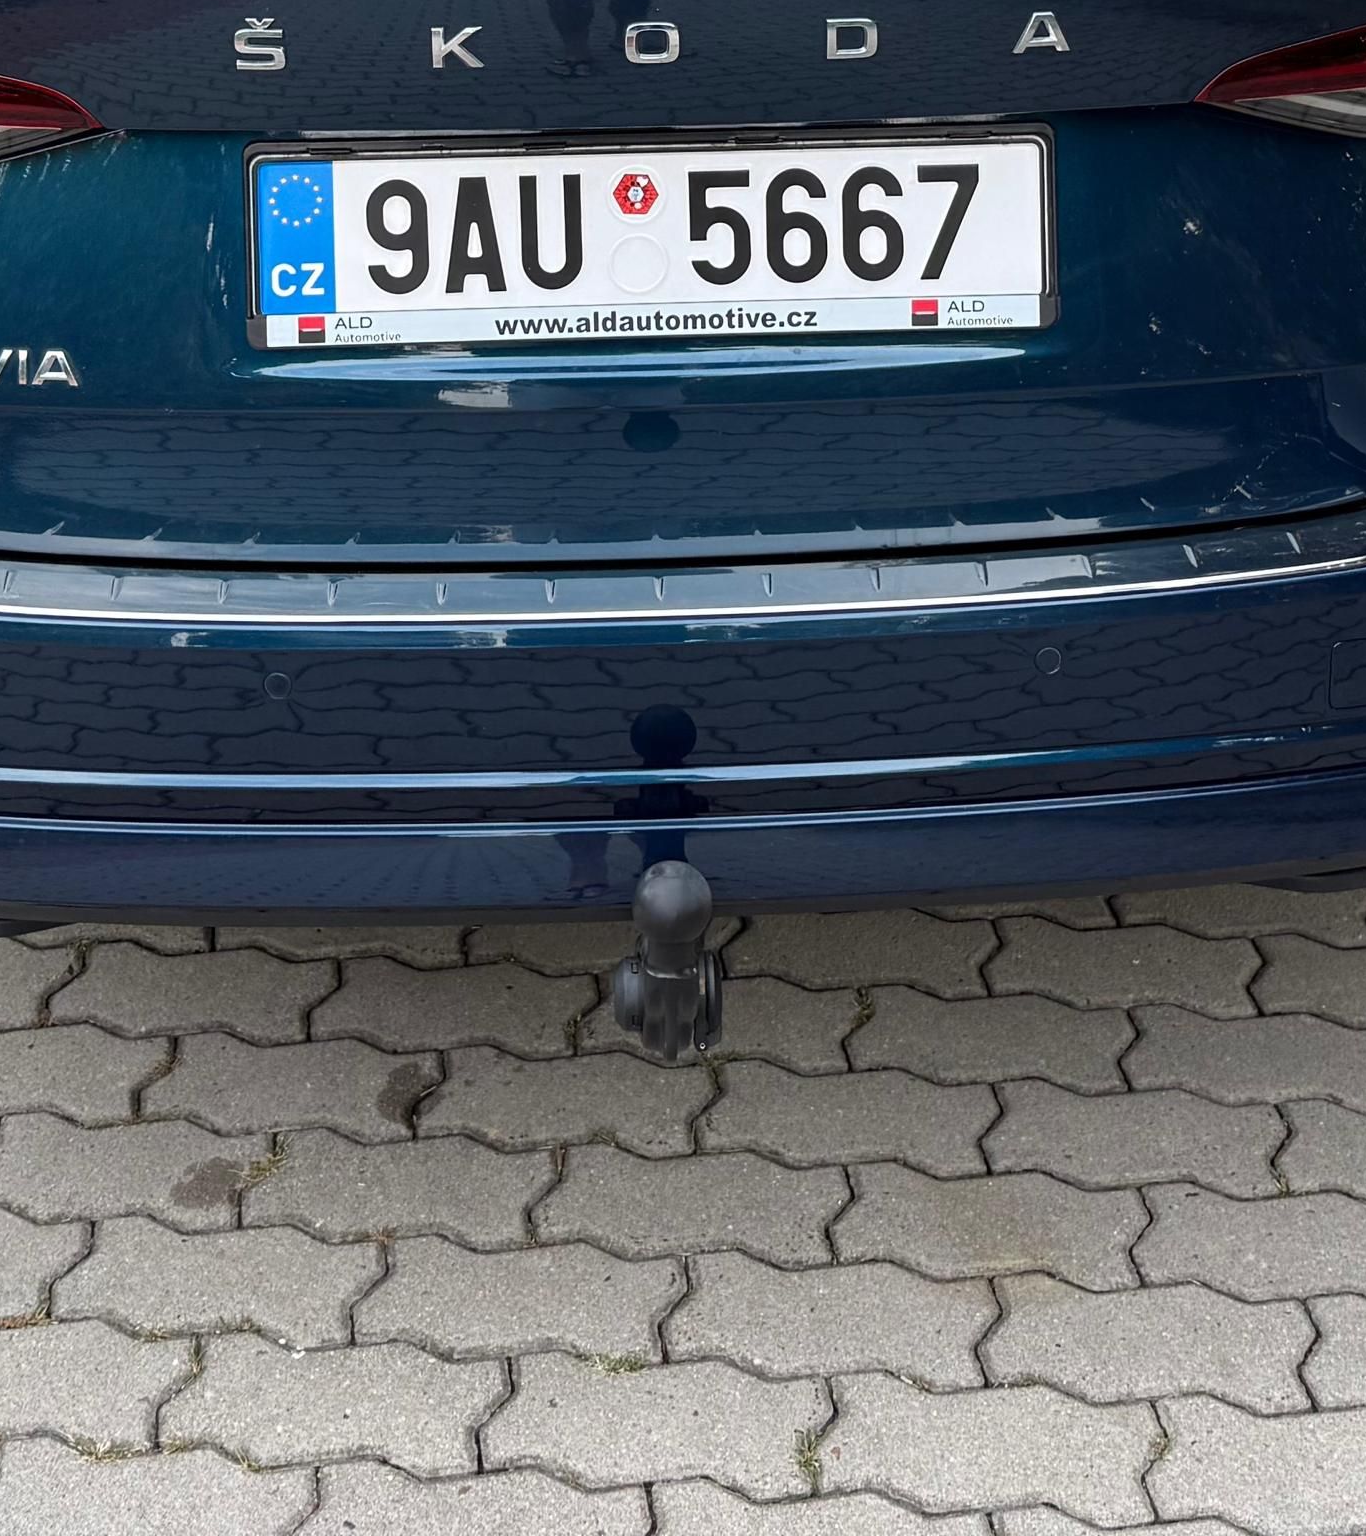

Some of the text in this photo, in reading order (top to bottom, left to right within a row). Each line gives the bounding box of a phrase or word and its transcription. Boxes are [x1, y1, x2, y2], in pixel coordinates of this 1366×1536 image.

[365, 163, 981, 295] 9AU 5667
[270, 262, 326, 297] CZ
[947, 300, 986, 313] ALD
[334, 316, 374, 330] ALD
[494, 307, 818, 336] www.aldautomotive.cz
[947, 315, 1014, 327] Automotive
[334, 331, 402, 344] Automotive
